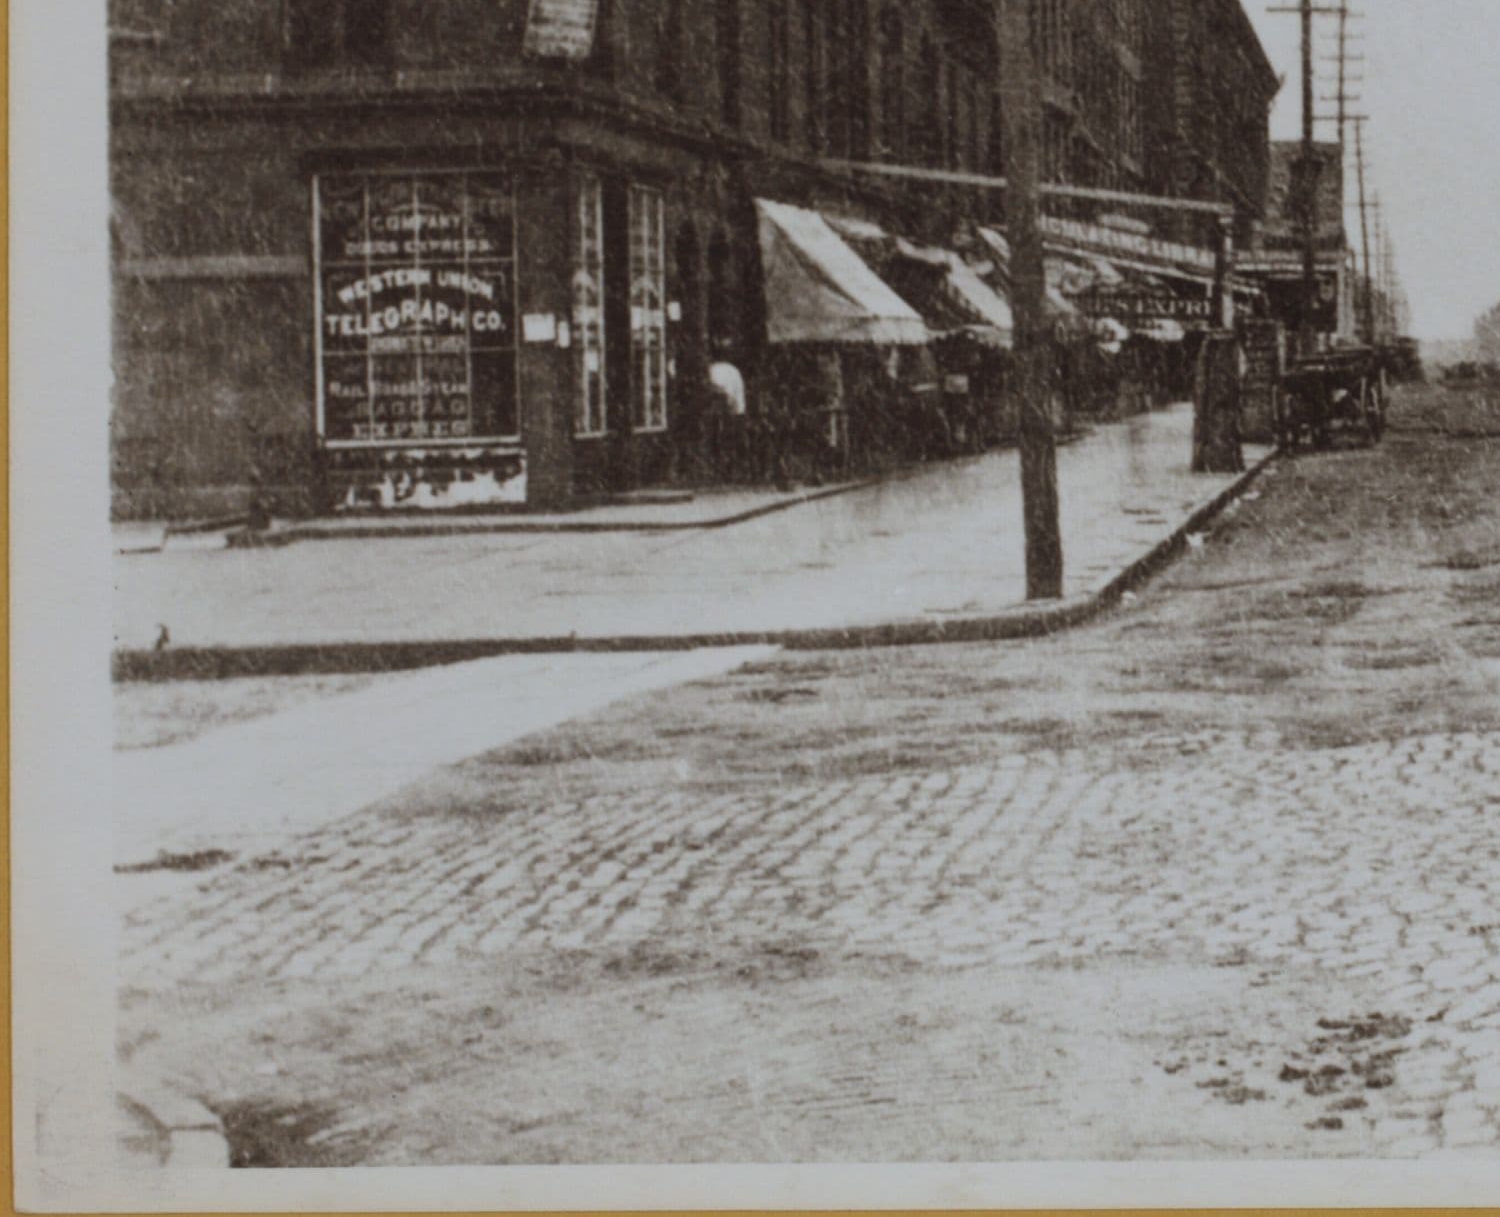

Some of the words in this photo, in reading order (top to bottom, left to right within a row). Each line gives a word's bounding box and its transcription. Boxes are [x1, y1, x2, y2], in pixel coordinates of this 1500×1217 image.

[370, 213, 461, 232] COMPANY
[337, 269, 432, 304] WESTERN
[437, 272, 494, 300] UNION
[326, 299, 466, 336] TELEGRAPH
[472, 312, 506, 332] CO.
